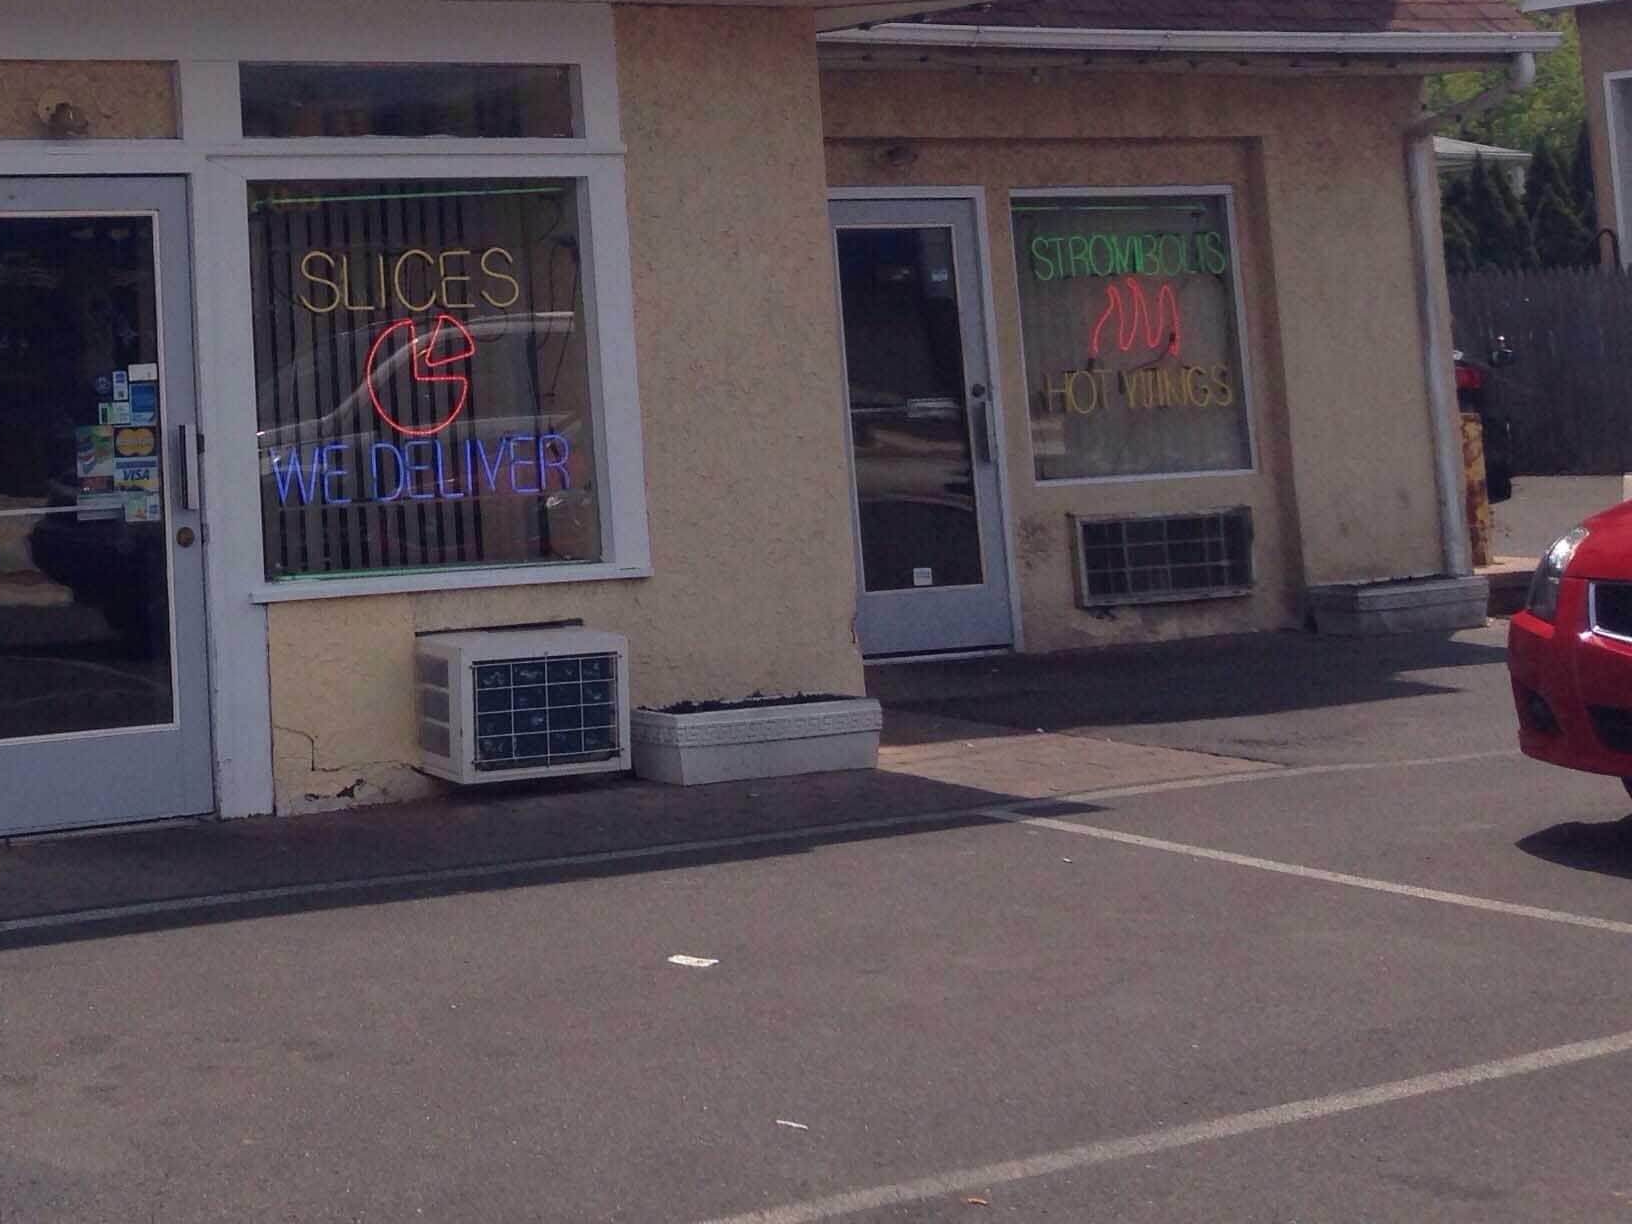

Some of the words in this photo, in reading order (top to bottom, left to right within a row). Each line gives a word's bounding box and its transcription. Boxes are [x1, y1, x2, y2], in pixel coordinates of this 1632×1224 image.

[299, 247, 519, 313] SLICES
[1031, 231, 1227, 280] STROMBOLIS
[1046, 368, 1113, 414] HOT
[1121, 364, 1233, 408] WINGS
[123, 469, 150, 481] VISA
[270, 441, 352, 505] WE
[369, 433, 570, 503] DELIVER
